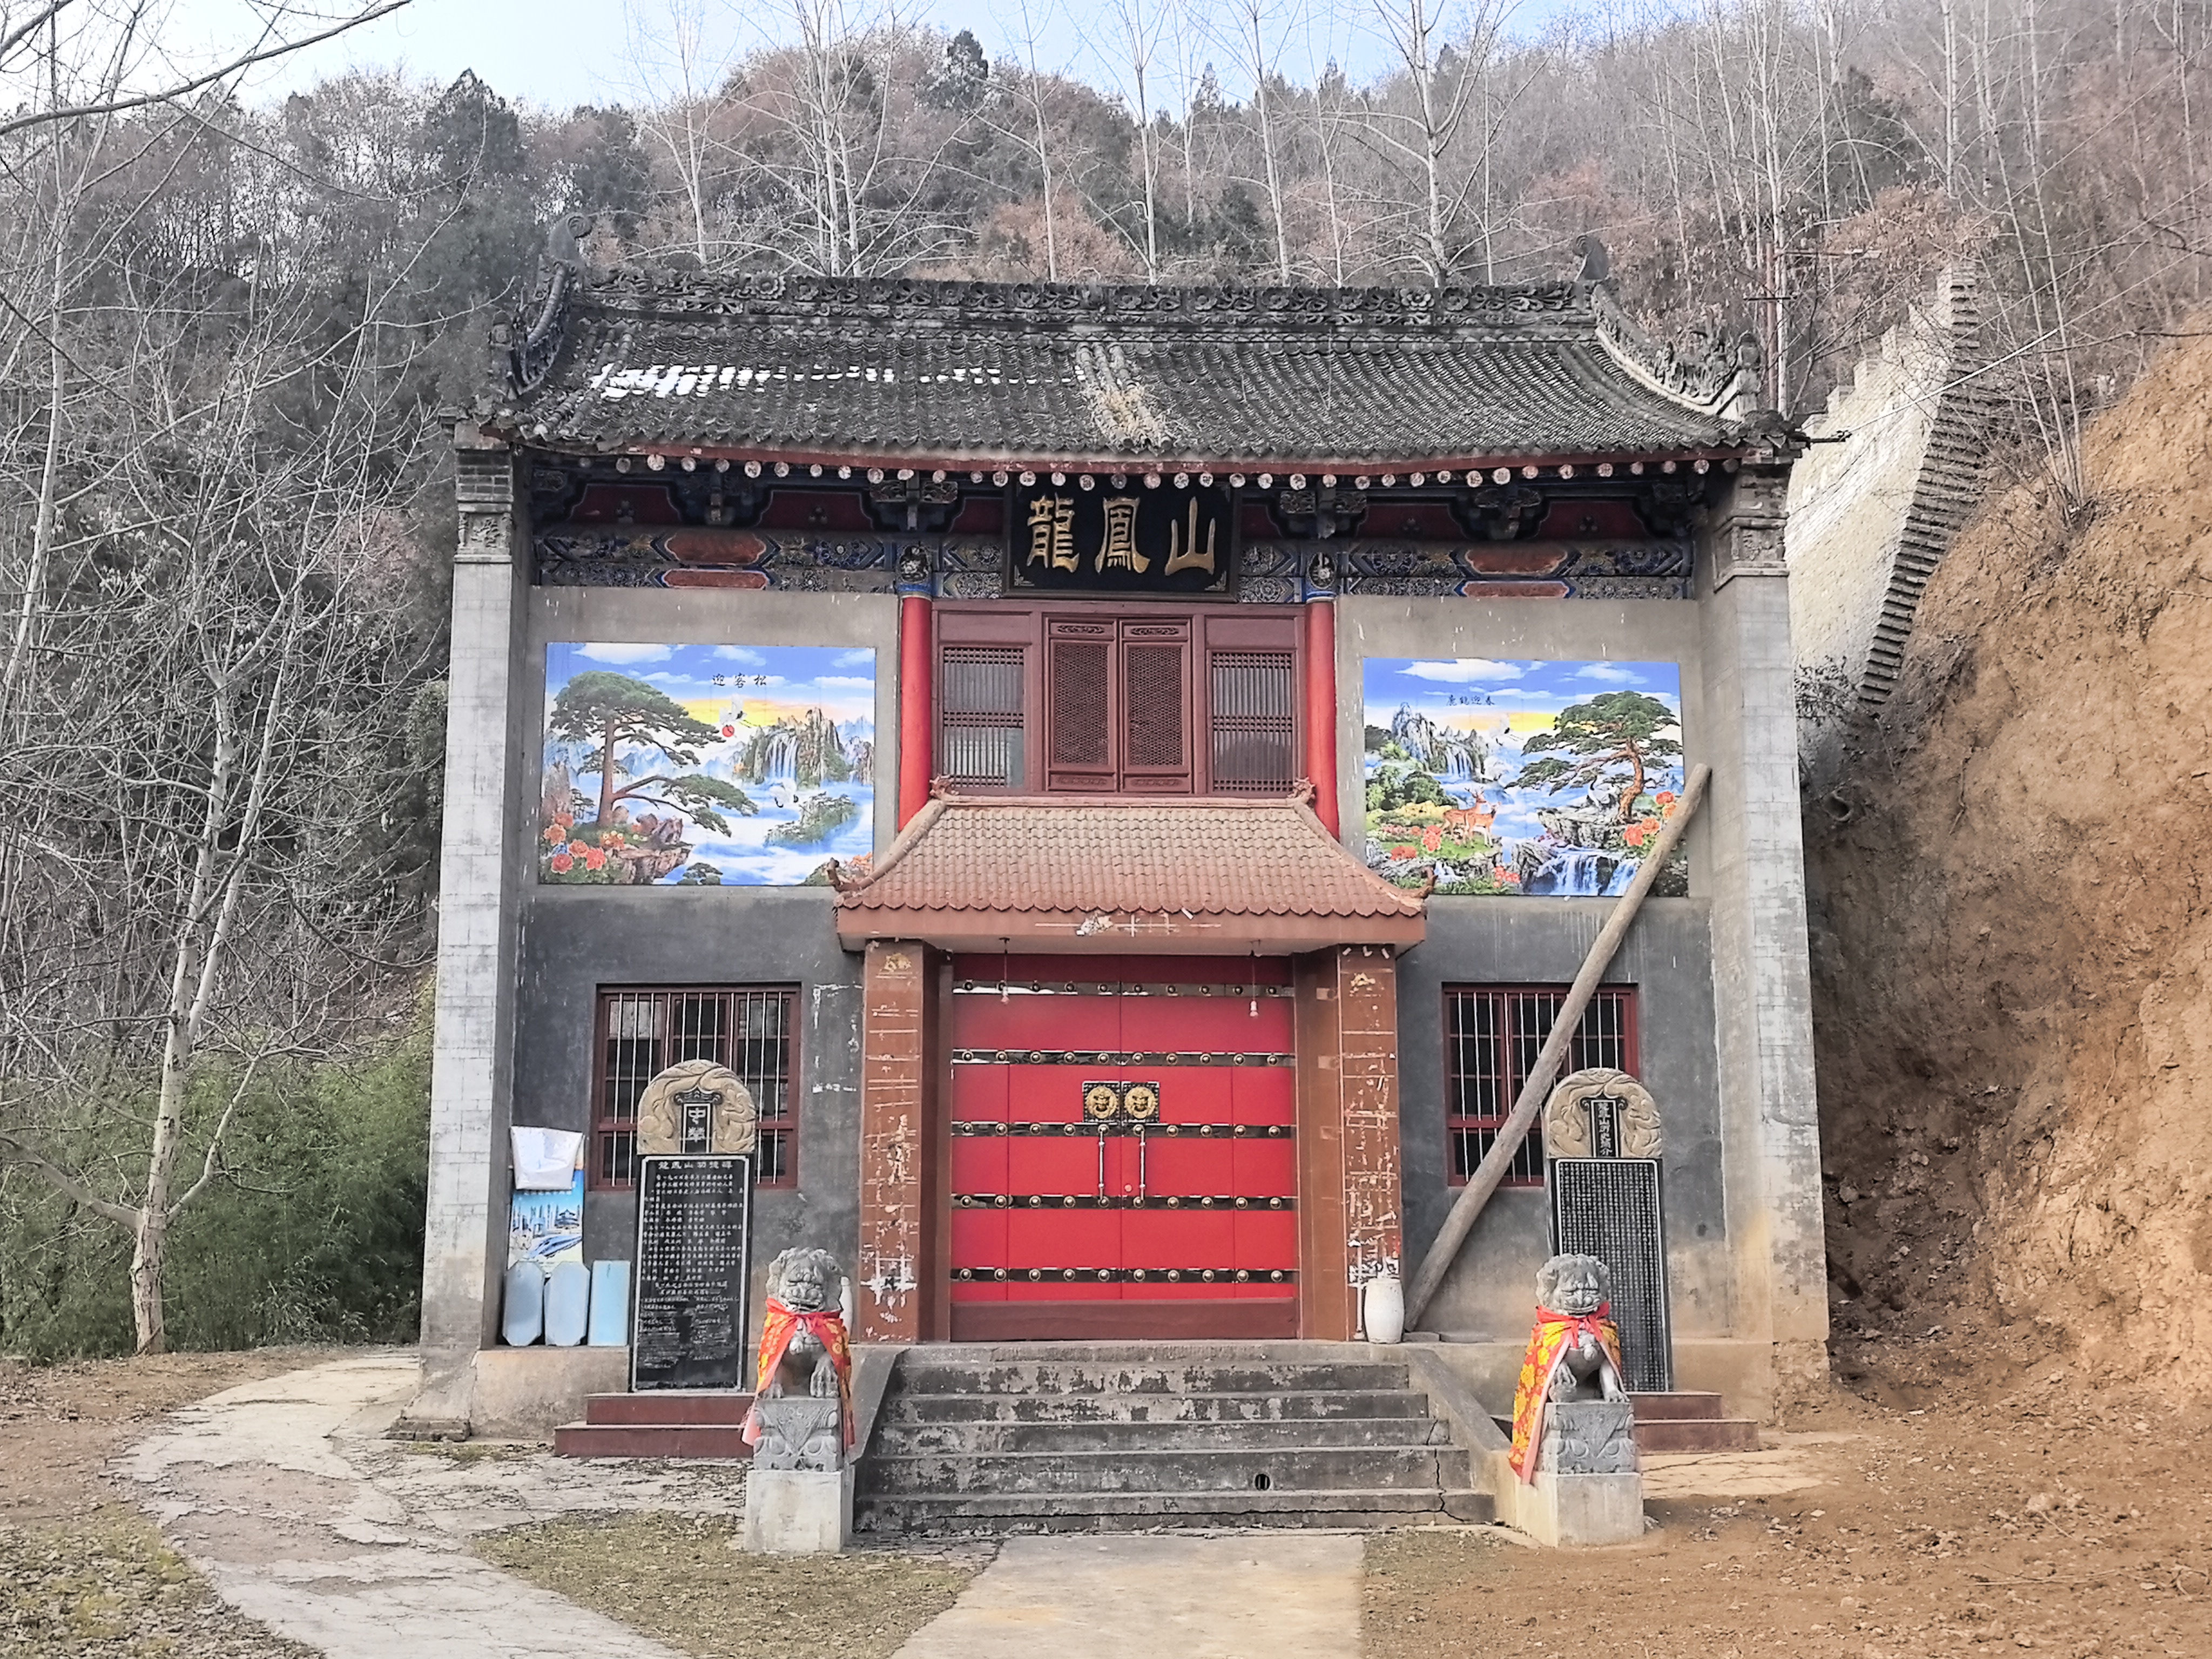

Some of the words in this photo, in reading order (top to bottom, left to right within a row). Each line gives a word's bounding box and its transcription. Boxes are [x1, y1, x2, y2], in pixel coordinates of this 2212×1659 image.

[1027, 492, 1216, 576] 龍鳳山
[712, 672, 766, 688] 迎客松
